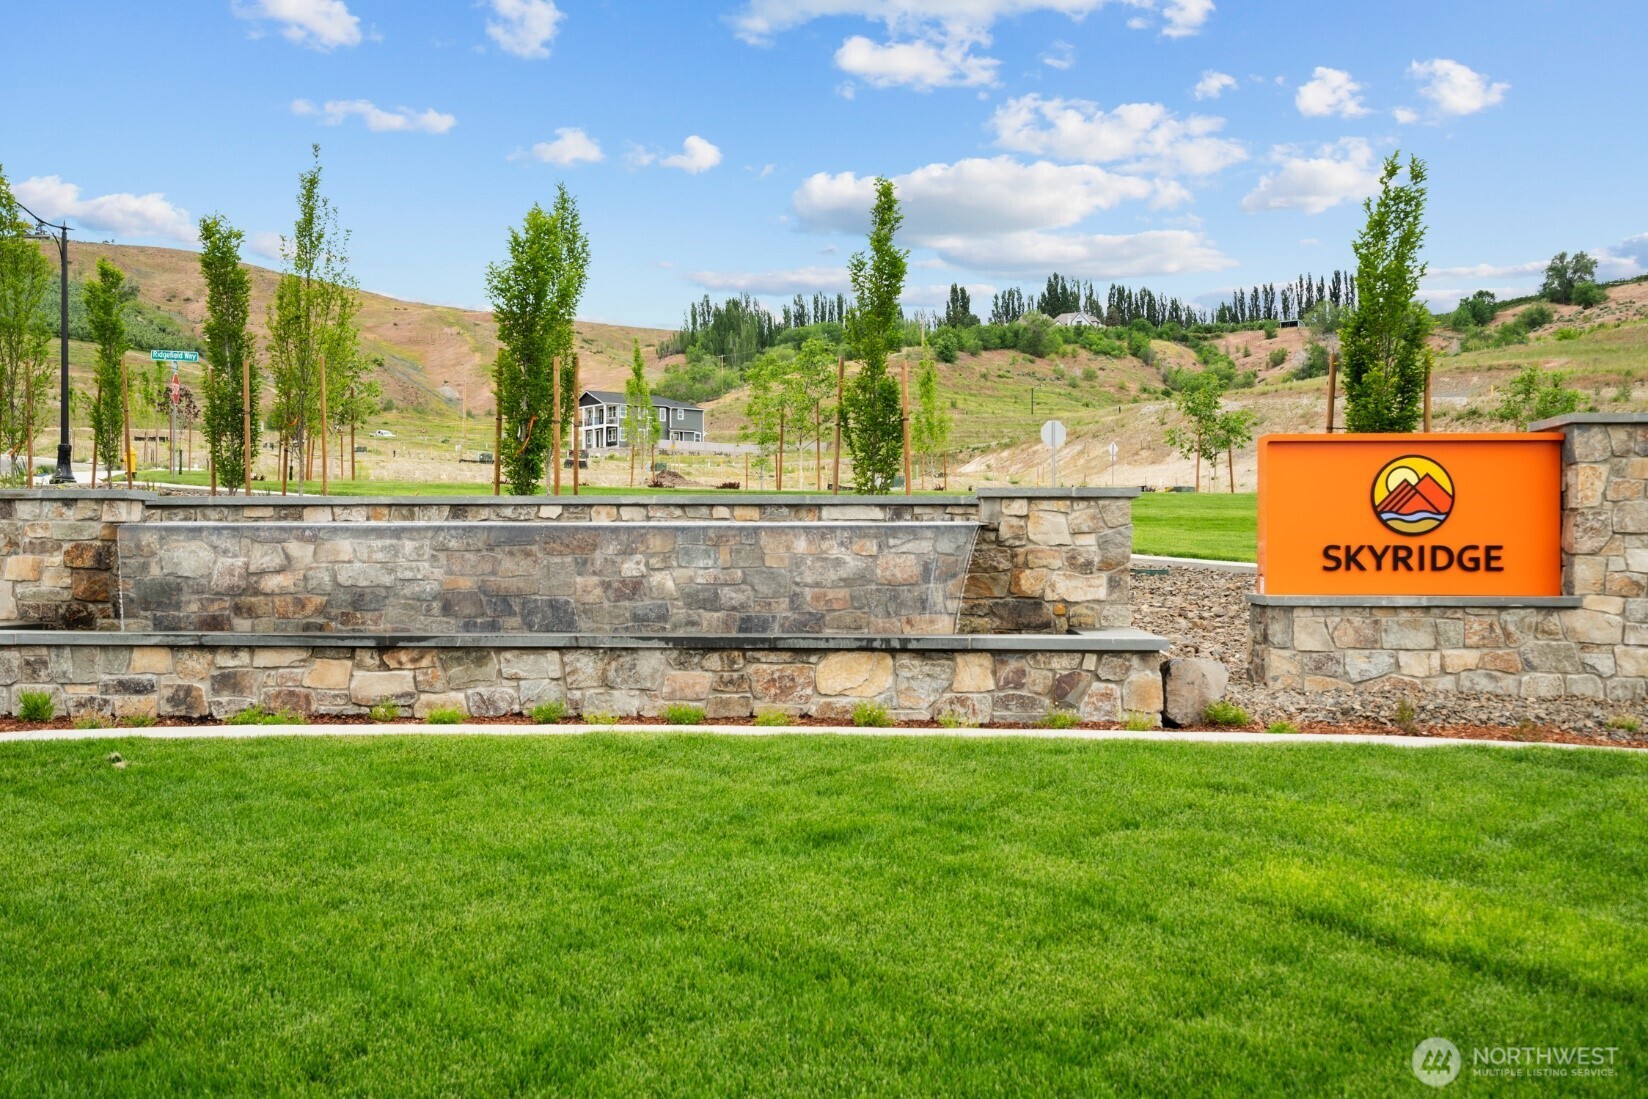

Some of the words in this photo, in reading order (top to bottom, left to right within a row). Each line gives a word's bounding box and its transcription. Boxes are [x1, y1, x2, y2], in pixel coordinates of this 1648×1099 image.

[153, 351, 182, 360] Ridgefield
[184, 352, 197, 361] Way
[1322, 544, 1504, 572] SKYRIDGE
